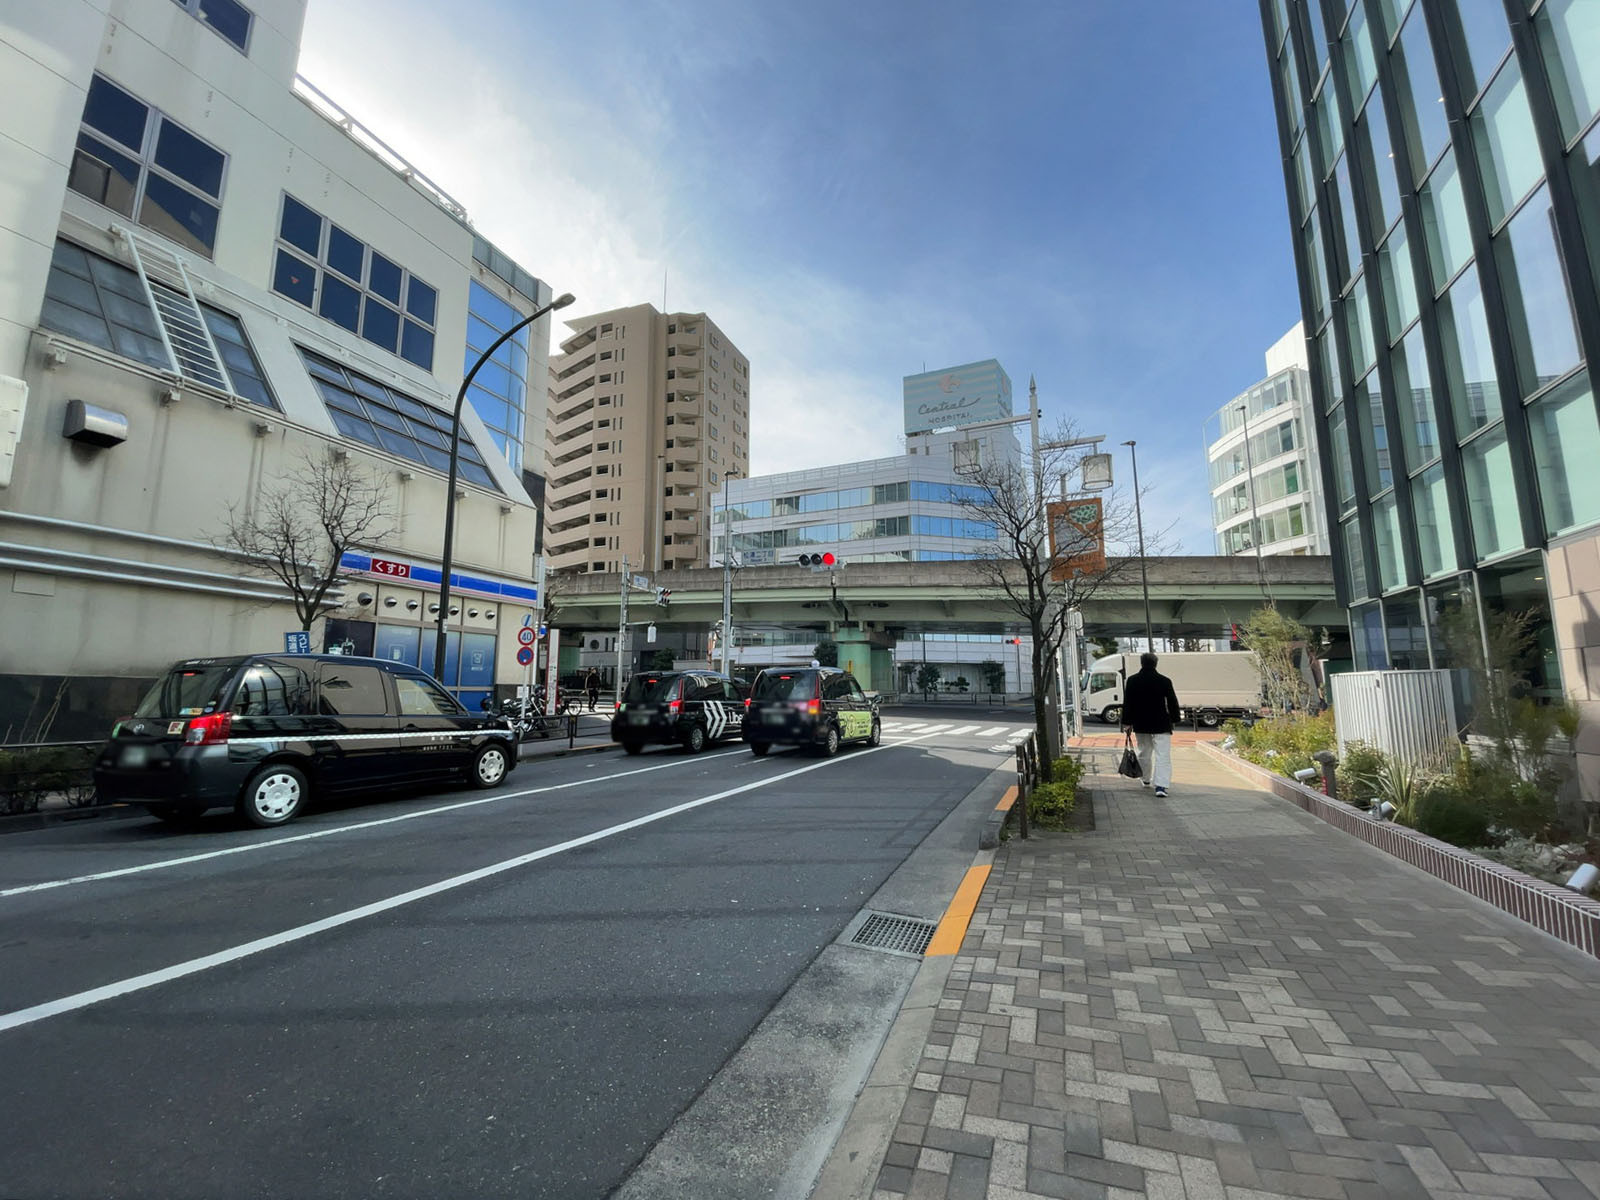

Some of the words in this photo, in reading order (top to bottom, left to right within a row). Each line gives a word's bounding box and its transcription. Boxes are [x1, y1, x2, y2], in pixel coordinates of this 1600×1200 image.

[918, 397, 983, 415] Central
[928, 412, 973, 424] HOSPITAL
[375, 561, 406, 576] くすり
[521, 631, 532, 641] 40
[728, 711, 744, 724] Ube
